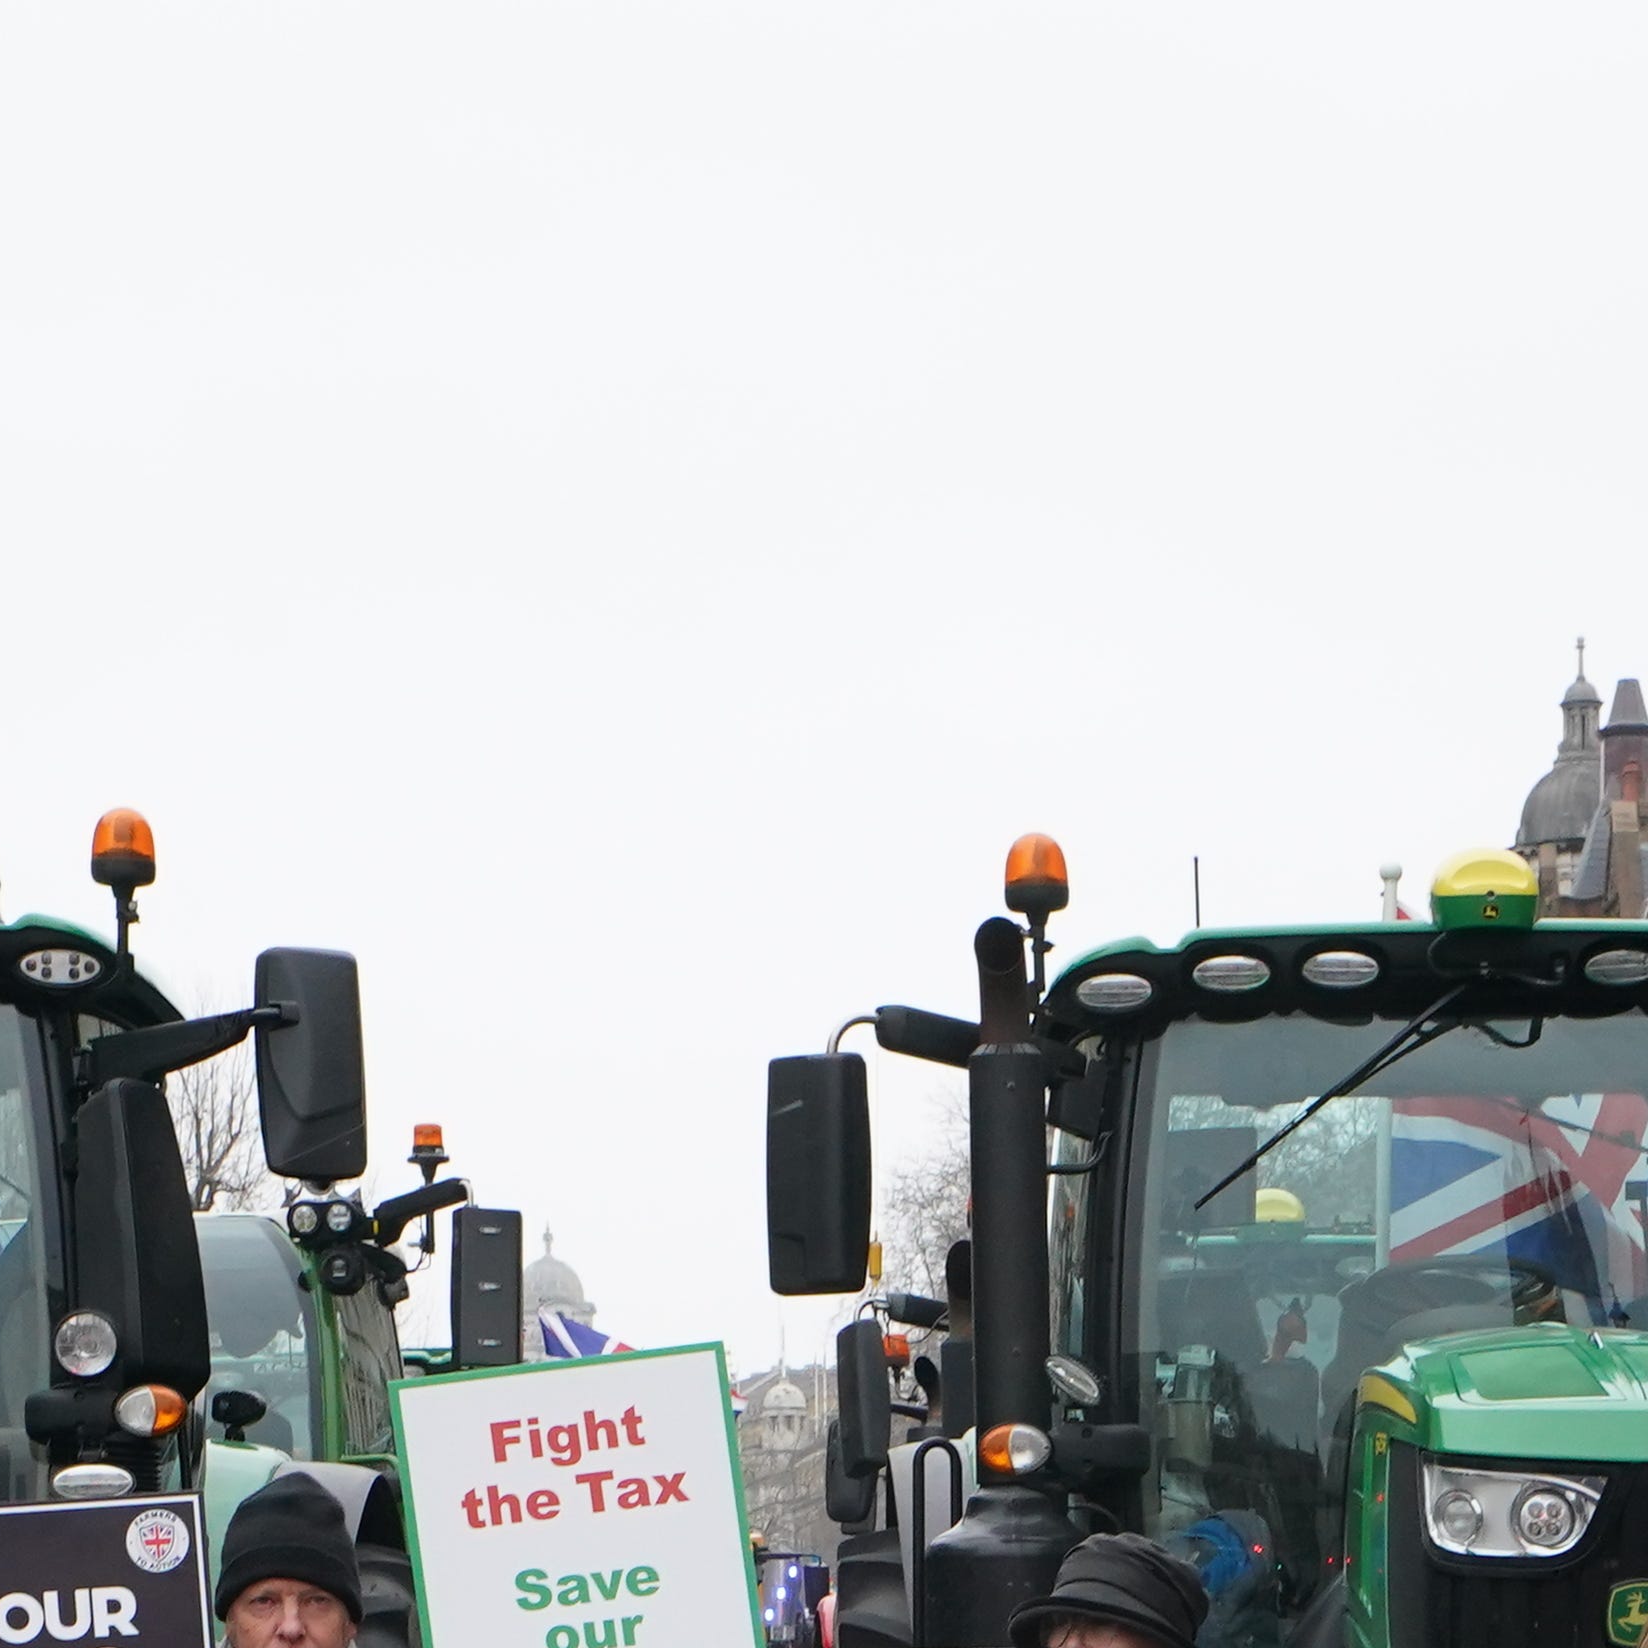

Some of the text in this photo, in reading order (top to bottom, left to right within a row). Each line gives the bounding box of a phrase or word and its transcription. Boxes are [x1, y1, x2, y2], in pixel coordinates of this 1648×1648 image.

[489, 1405, 646, 1467] Fight
[461, 1470, 690, 1529] the Tax
[514, 1565, 659, 1610] Save
